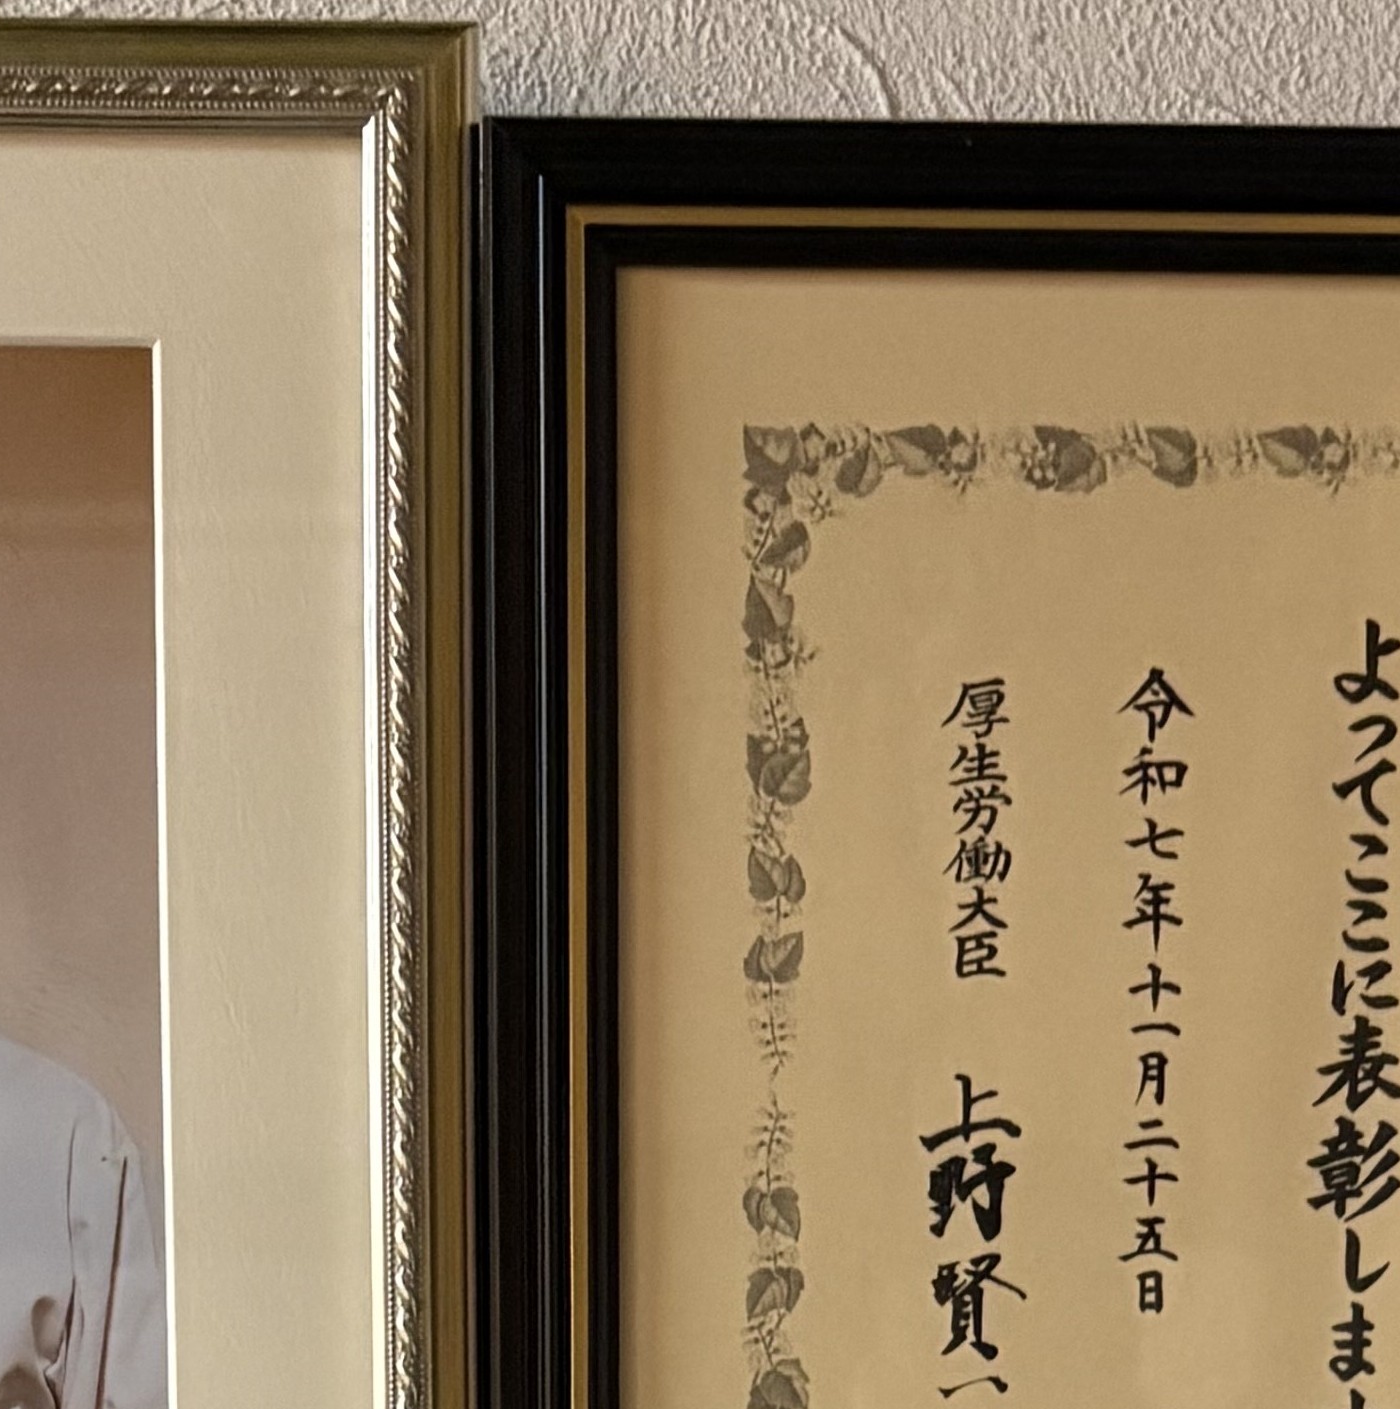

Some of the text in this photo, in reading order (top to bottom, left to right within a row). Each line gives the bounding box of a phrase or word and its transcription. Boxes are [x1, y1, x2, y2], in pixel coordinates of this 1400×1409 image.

[939, 675, 1014, 981] 厚生労働大臣
[1116, 665, 1197, 1315] 令和七年十一月二十五日
